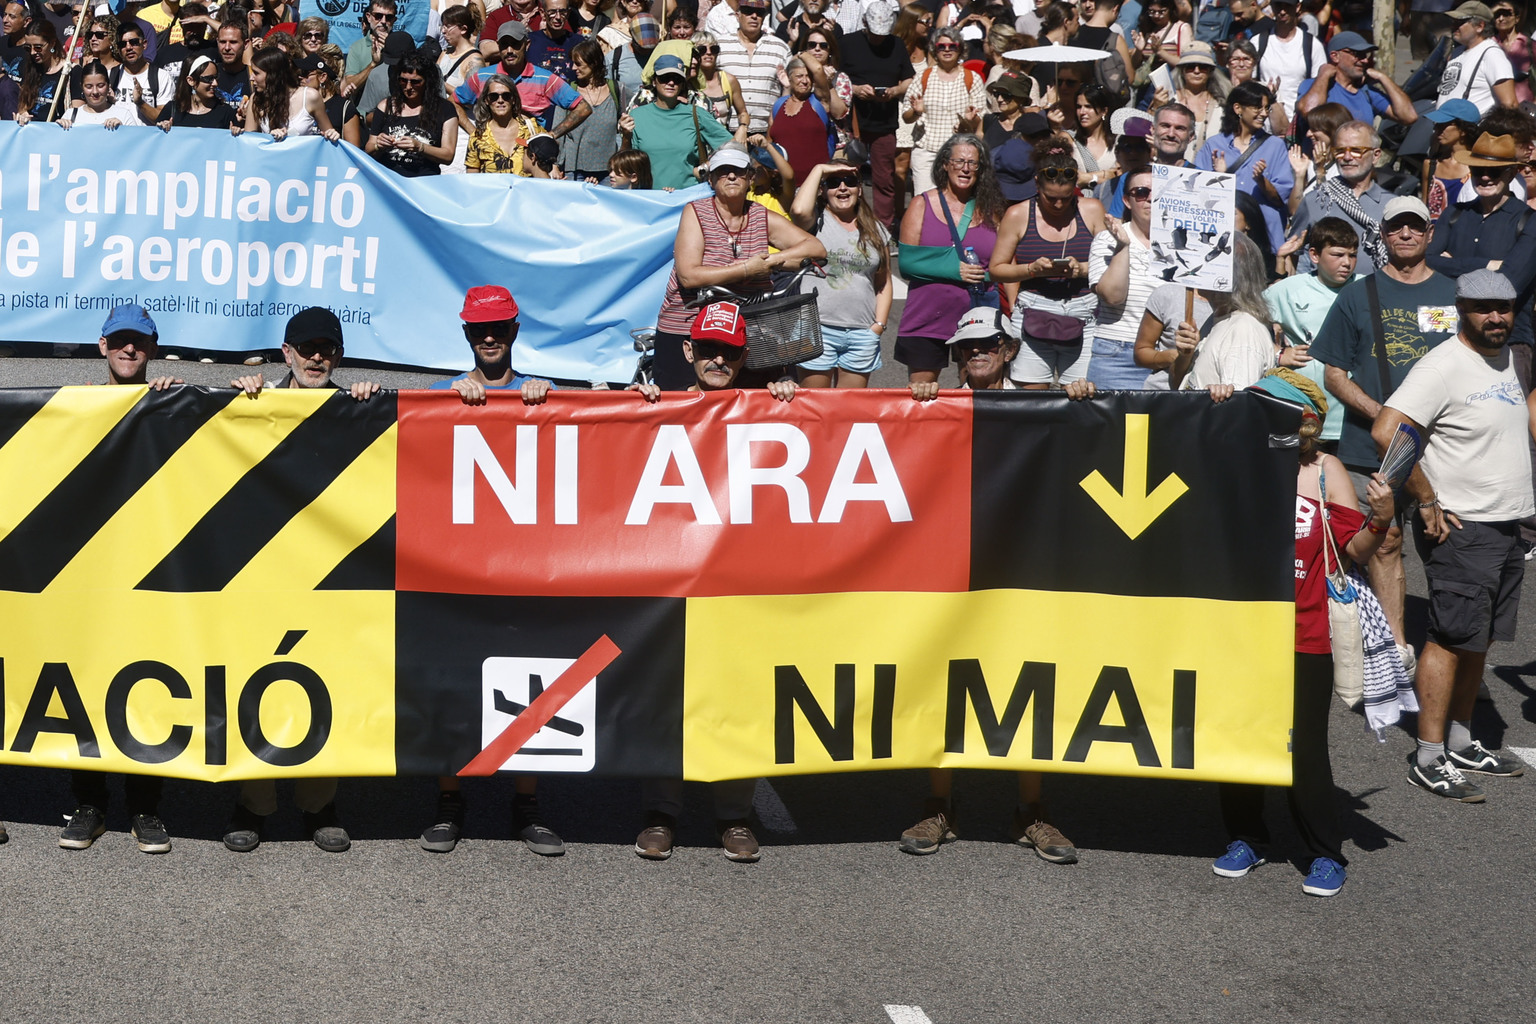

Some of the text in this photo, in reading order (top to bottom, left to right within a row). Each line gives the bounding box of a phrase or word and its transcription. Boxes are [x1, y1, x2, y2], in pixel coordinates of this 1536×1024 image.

[352, 1, 366, 13] DE
[1152, 165, 1168, 176] NO
[27, 153, 364, 230] l'ampliació
[1159, 197, 1191, 207] AVIONS
[1158, 203, 1225, 219] INTERESSANTS
[1192, 215, 1218, 224] VOLEN
[1173, 218, 1218, 235] DELTA
[61, 220, 380, 301] l'aeroport!
[11, 291, 49, 312] pista
[54, 291, 68, 310] ni
[204, 299, 218, 317] ni
[222, 300, 265, 318] ciutat
[451, 422, 914, 525] NI ARA
[774, 658, 1197, 770] NI MAI
